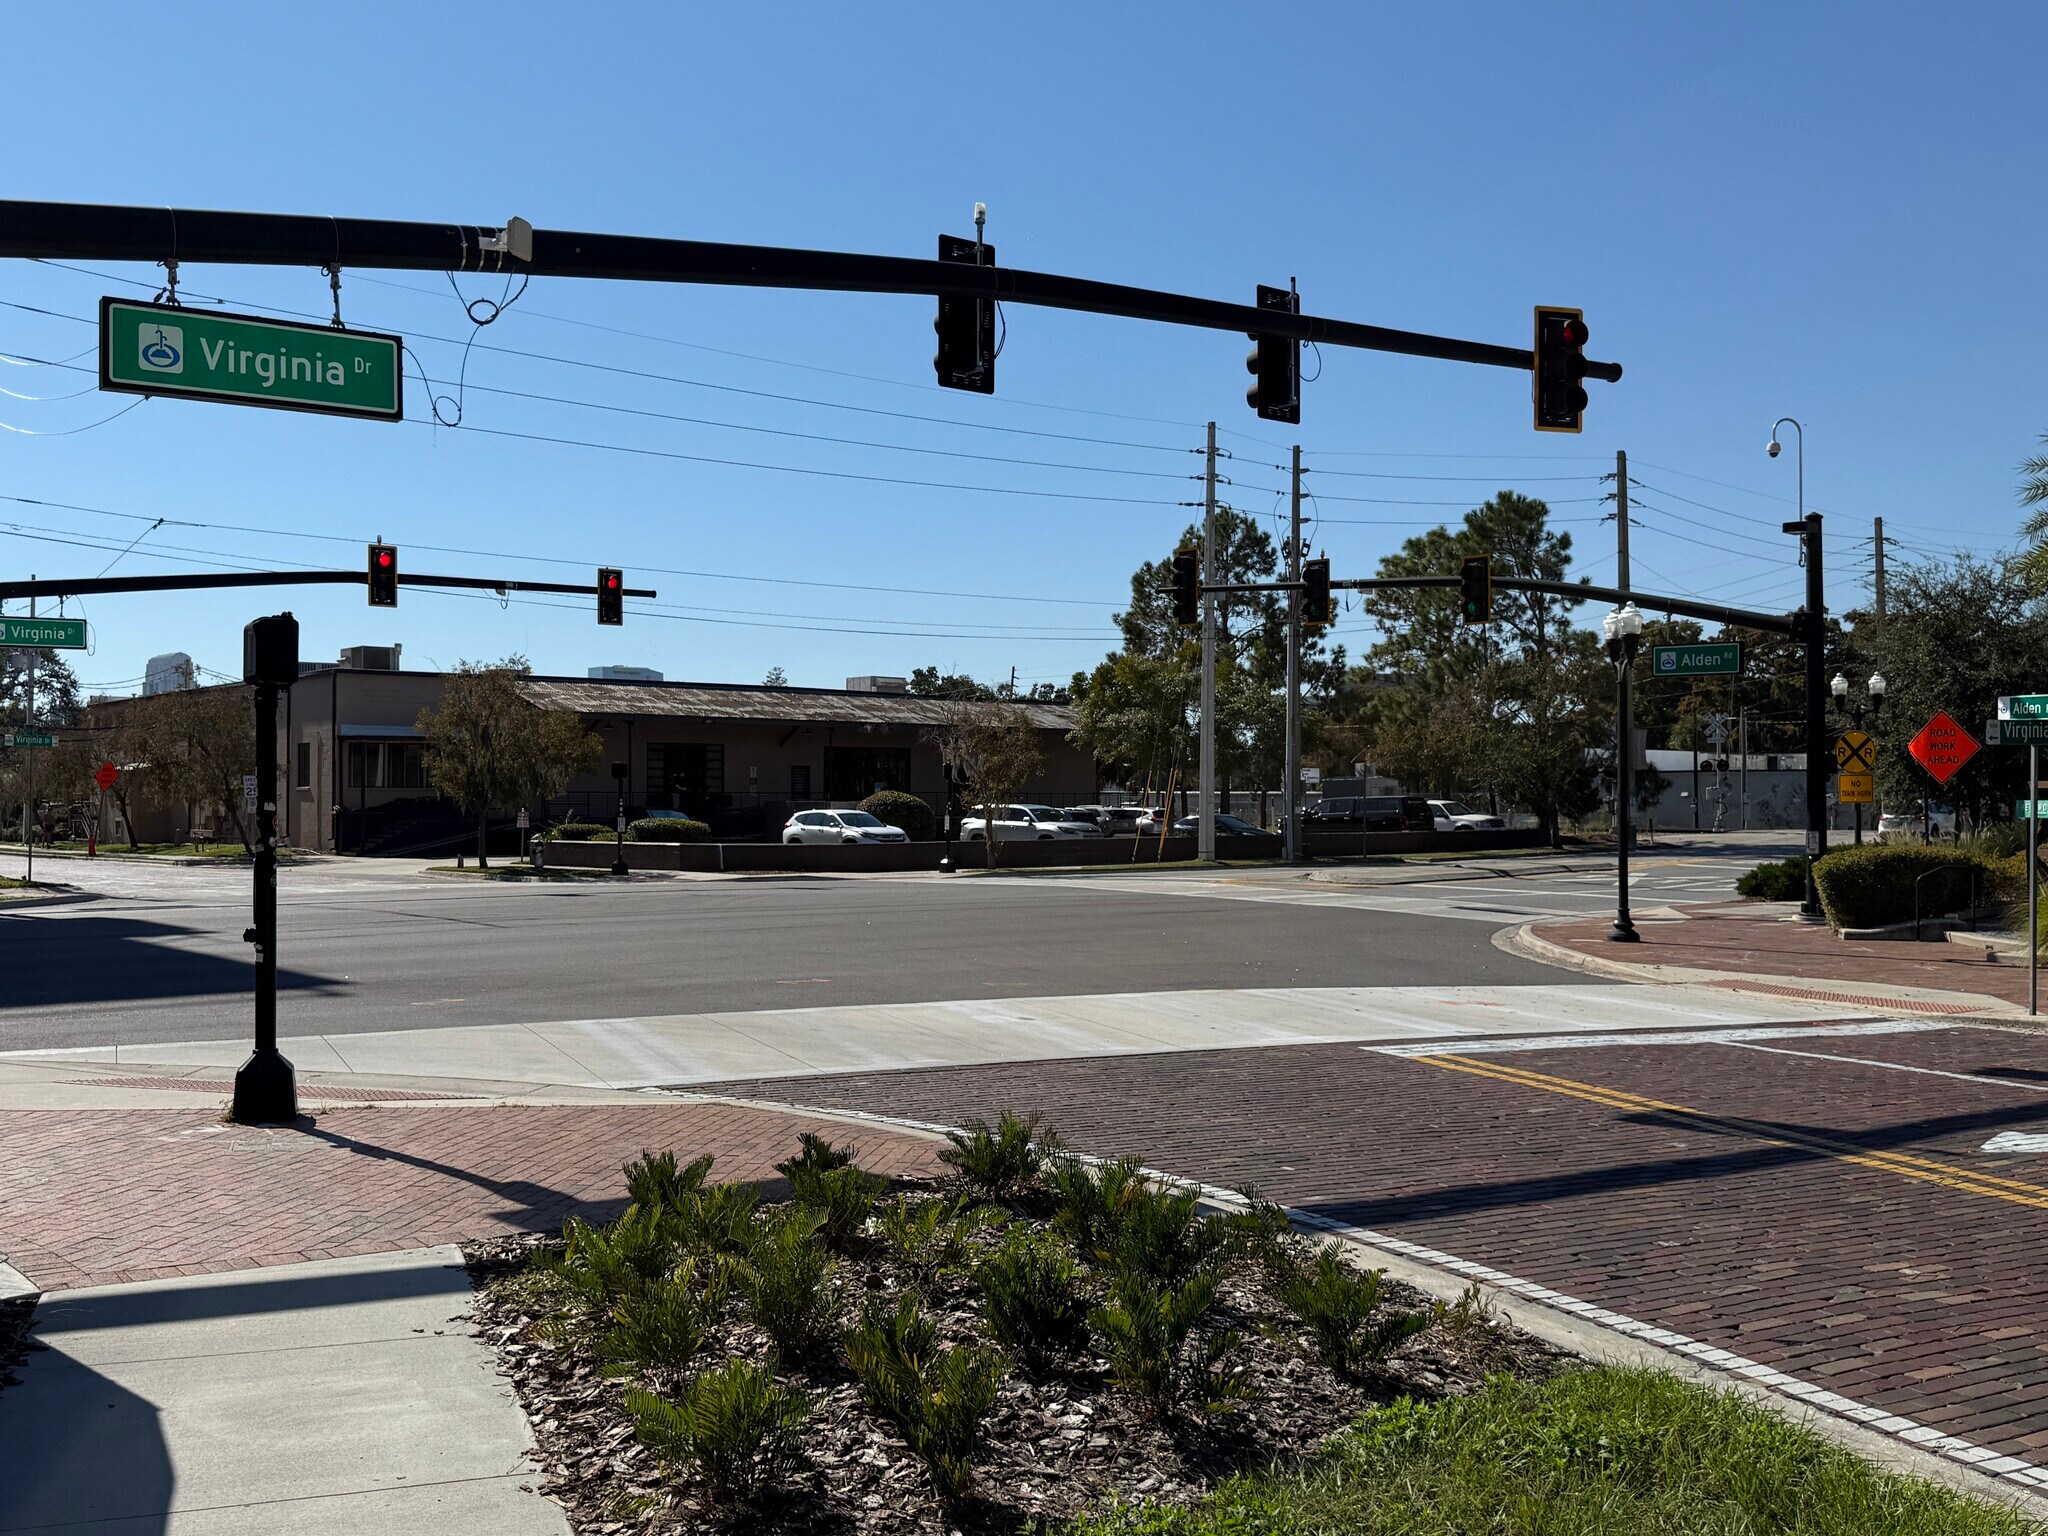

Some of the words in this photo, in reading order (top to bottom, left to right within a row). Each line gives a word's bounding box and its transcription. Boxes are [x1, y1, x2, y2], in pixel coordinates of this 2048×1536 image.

[200, 337, 345, 387] Virginia
[354, 357, 372, 374] Dr
[11, 626, 65, 642] Virginia
[1681, 653, 1721, 667] Alden
[2012, 701, 2041, 715] Alden
[1929, 728, 1957, 737] ROAD
[16, 735, 43, 745] Virginia
[1929, 742, 1956, 751] WORK
[1838, 747, 1846, 758] R
[1864, 747, 1873, 758] R
[1927, 755, 1960, 765] AHEAD
[1850, 780, 1861, 788] NO
